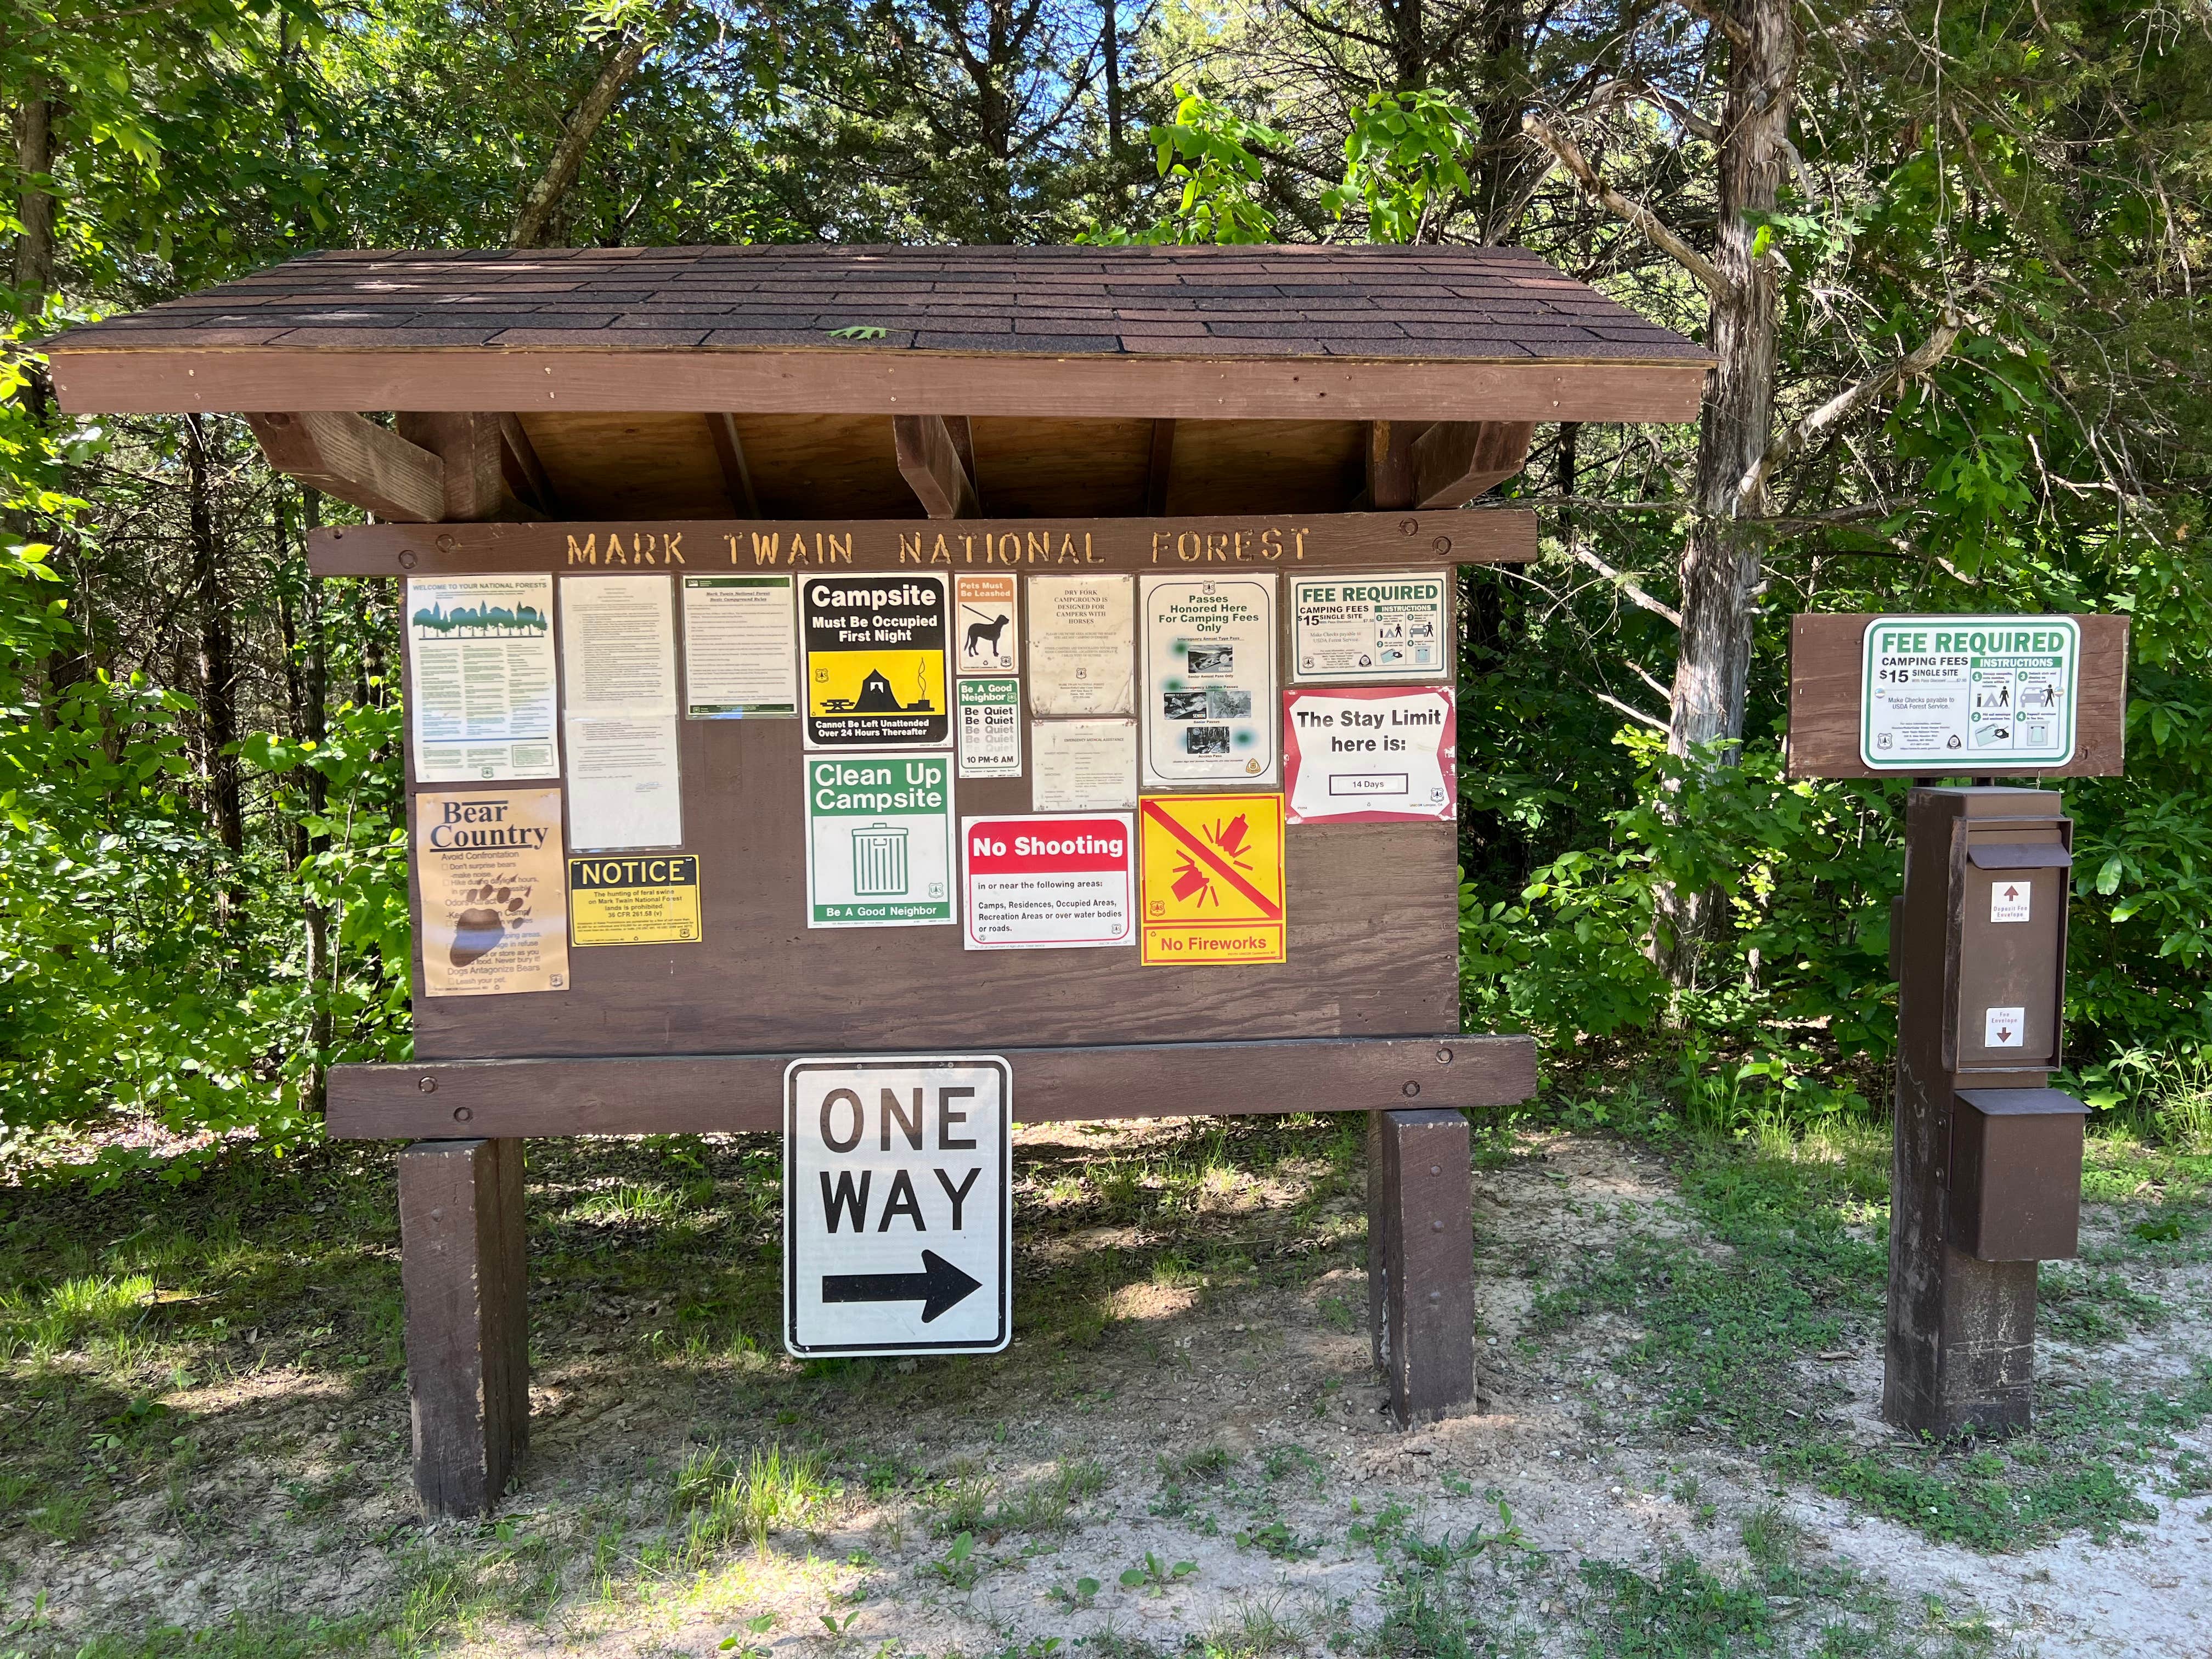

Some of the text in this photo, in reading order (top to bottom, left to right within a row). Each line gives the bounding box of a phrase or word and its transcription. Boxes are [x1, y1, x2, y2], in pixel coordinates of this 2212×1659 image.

[567, 528, 1310, 565] MARK TWAIN NATIONAL FOREST
[811, 584, 936, 611] Campsite
[1303, 585, 1437, 602] FEE REQUIRED
[812, 615, 937, 629] Must Be Occupied
[1181, 614, 1229, 623] Camping
[1197, 624, 1221, 633] Only
[839, 629, 912, 643] First Night
[1882, 633, 2064, 655] FEE REQUIRED
[1882, 657, 1968, 665] CAMPING FEES
[1980, 658, 2053, 667] INSTRUCTIONS
[988, 684, 1012, 692] Good
[962, 693, 1006, 703] Neighbor
[984, 707, 1013, 715] Quiet
[815, 720, 845, 729] Cannot
[985, 716, 1013, 724] Quiet
[1297, 709, 1441, 729] The Stay Limit
[1332, 735, 1406, 752] here is:
[815, 763, 941, 789] Clean Up
[1364, 781, 1384, 789] Days
[815, 788, 942, 812] Campsite
[442, 802, 508, 823] Bear
[430, 825, 549, 850] Country
[973, 835, 1123, 857] No Shooting
[466, 851, 519, 859] Confrontation
[582, 860, 685, 884] NOTICE
[826, 906, 936, 917] Be A Good Neighbor
[979, 901, 1006, 910] Camps,
[1009, 901, 1054, 909] Residences,
[1056, 900, 1091, 908] Occupied
[1161, 936, 1266, 951] No Fireworks
[820, 1087, 977, 1153] ONE
[820, 1168, 982, 1233] WAY
